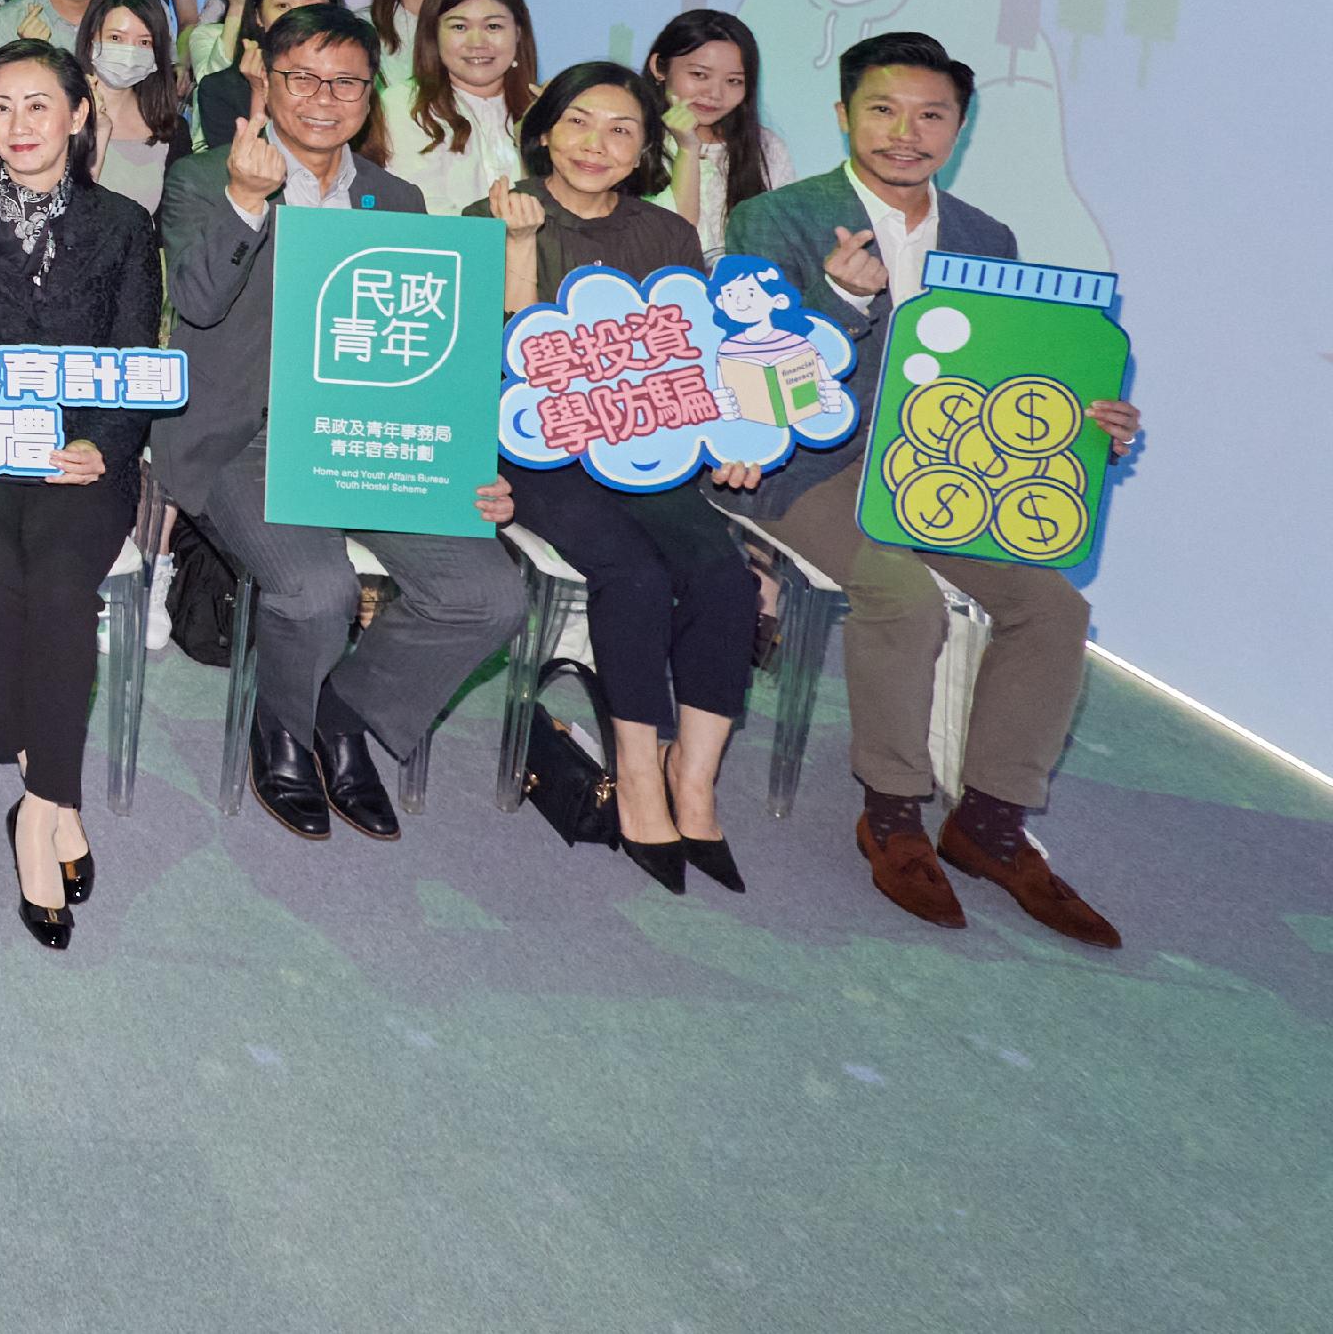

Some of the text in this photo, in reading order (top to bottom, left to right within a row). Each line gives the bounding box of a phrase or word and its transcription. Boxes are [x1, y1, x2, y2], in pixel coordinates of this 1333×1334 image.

[353, 269, 448, 320] 民政
[330, 318, 430, 366] 青年
[521, 304, 702, 393] 學投資
[782, 360, 814, 377] financial
[785, 371, 814, 385] literacy
[538, 365, 721, 453] 學防騙
[314, 417, 452, 442] 民政及青年事務局
[331, 439, 434, 462] 青年宿舍計劃
[313, 467, 449, 484] Home and Youth Affairs Bureau
[335, 480, 428, 494] Youth Hostel Scheme
